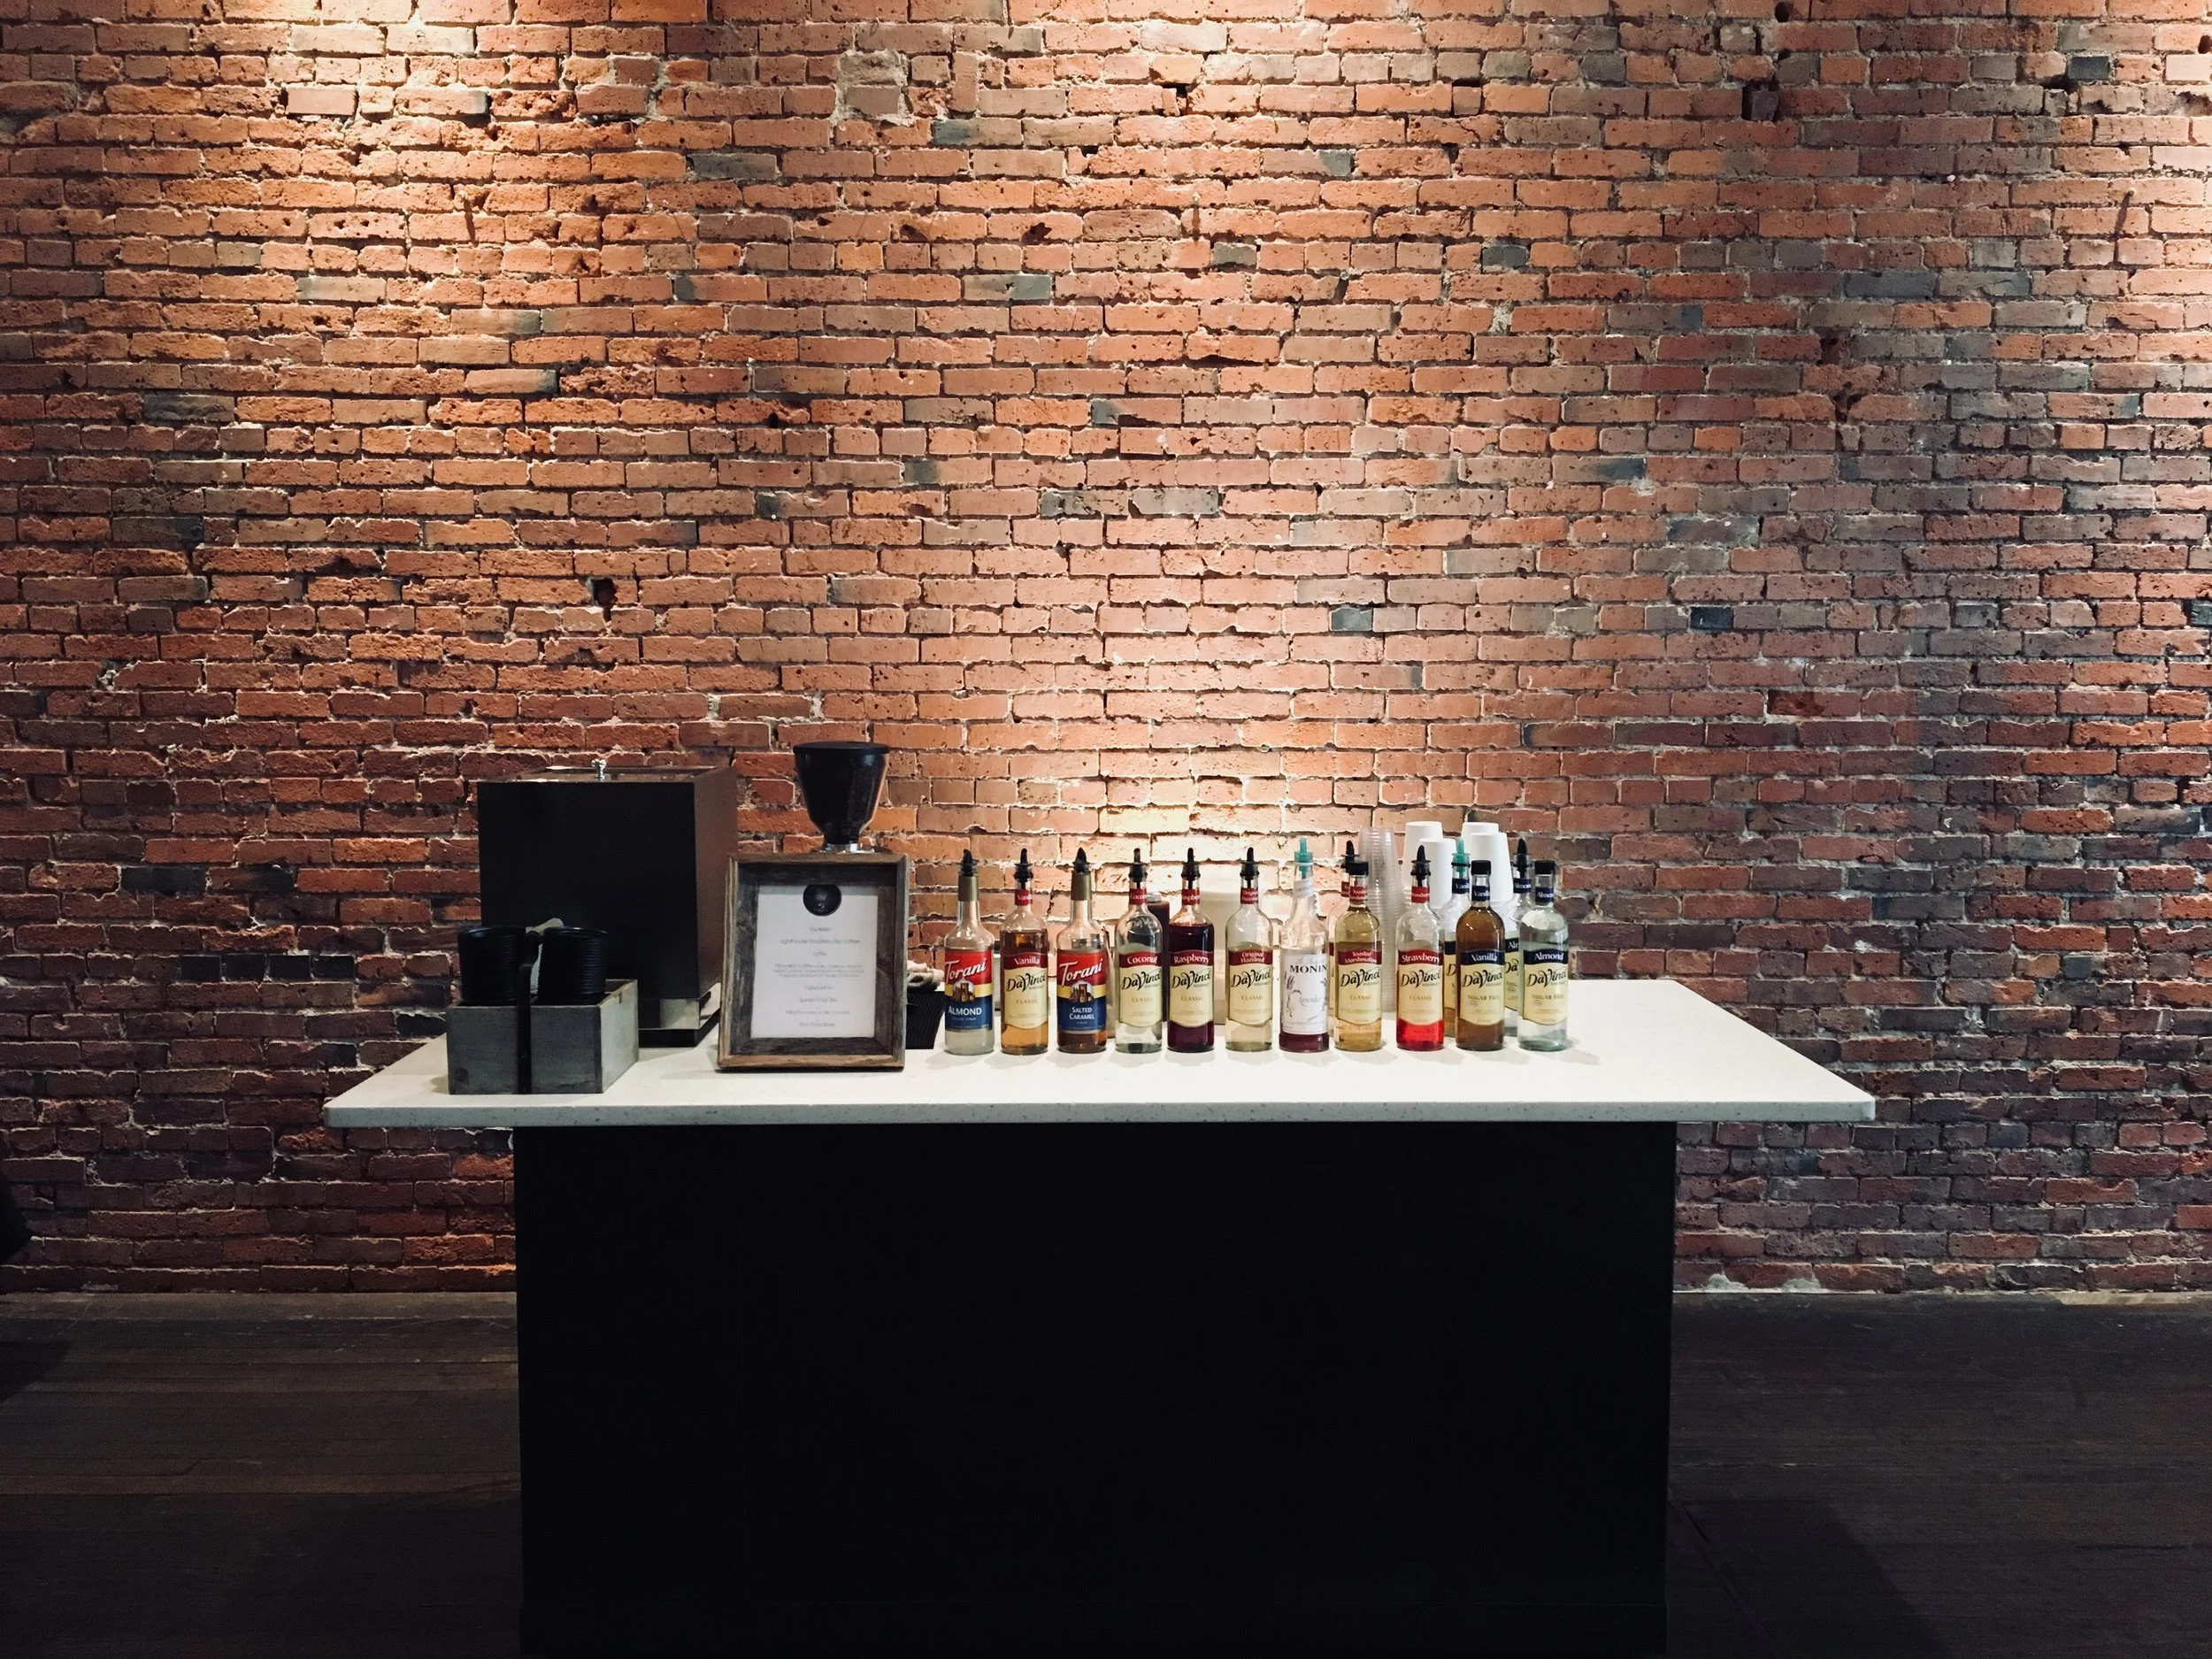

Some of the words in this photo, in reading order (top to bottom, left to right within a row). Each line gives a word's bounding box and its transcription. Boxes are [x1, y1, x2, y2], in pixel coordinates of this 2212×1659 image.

[1014, 956, 1041, 965] Vanilla
[1126, 956, 1158, 964] Coconut
[1173, 953, 1210, 965] Raspberry
[1402, 953, 1440, 965] Strawberry
[1471, 953, 1497, 962] Vanilla
[1534, 952, 1564, 961] Almond
[945, 957, 987, 984] Torani
[1059, 957, 1103, 987] Torani
[1289, 964, 1327, 973] MONIN
[948, 1005, 982, 1016] ALMOND
